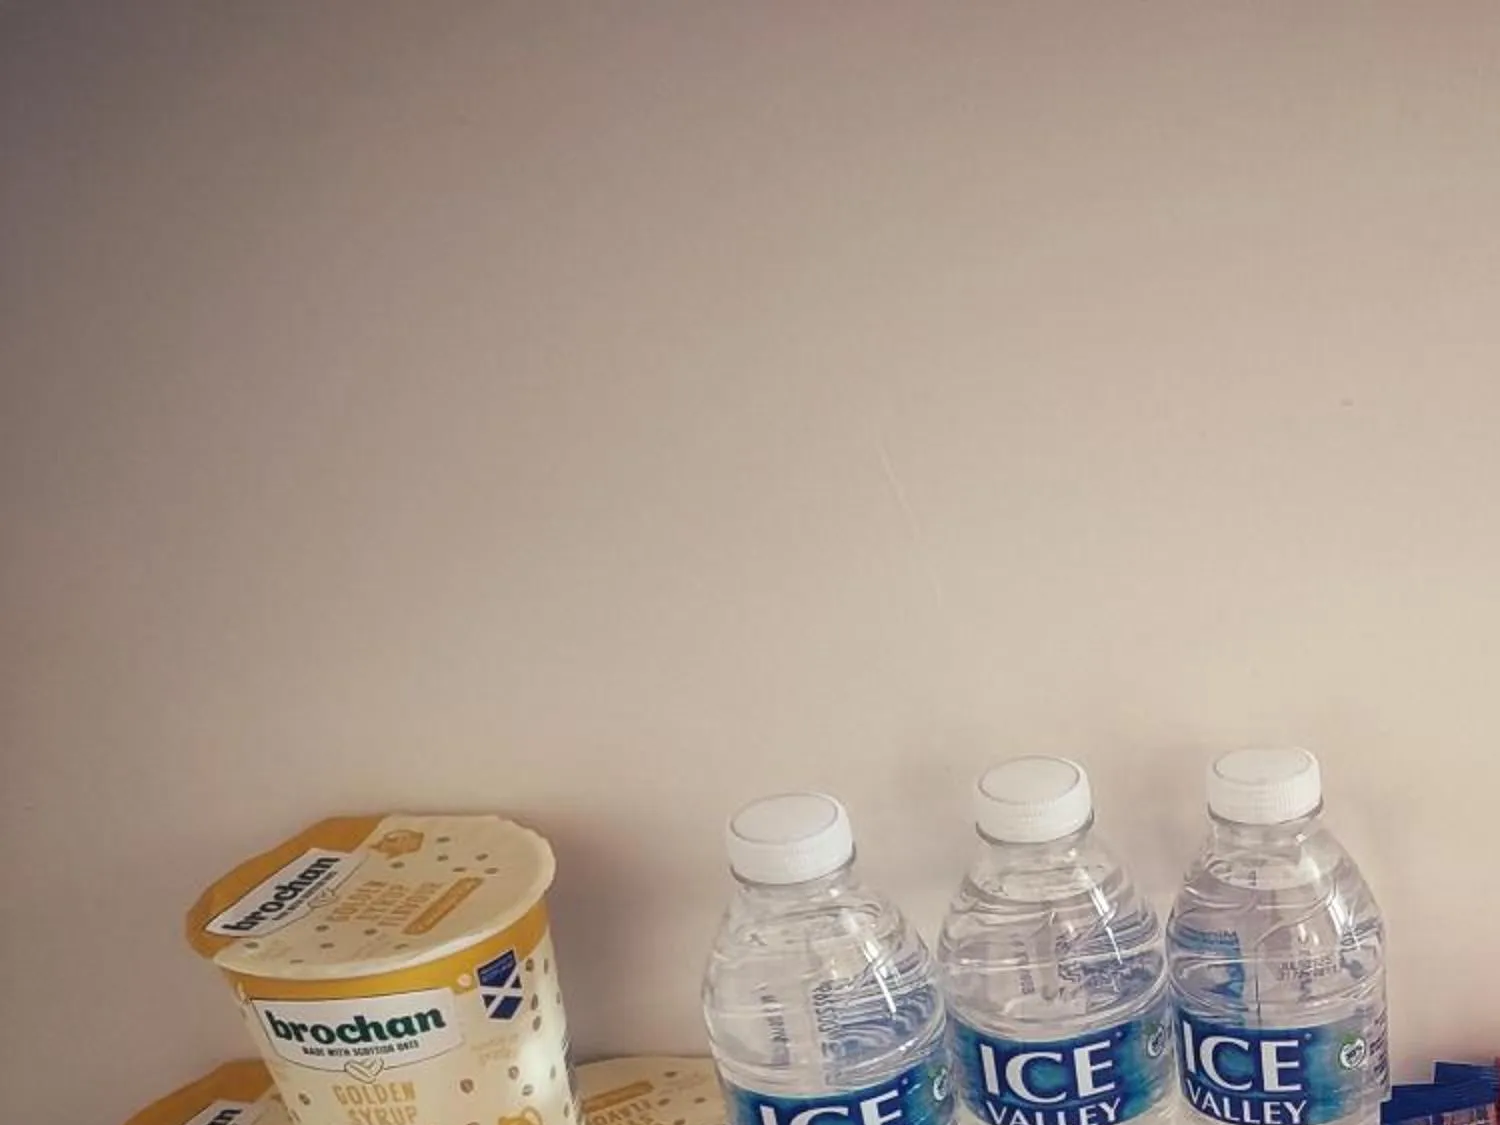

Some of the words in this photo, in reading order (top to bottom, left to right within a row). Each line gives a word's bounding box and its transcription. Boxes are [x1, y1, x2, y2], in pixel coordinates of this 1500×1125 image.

[220, 856, 341, 932] brochan
[264, 1008, 447, 1046] brochan
[980, 1039, 1116, 1104] ICE
[1183, 1020, 1303, 1093] ICE
[331, 1081, 417, 1105] GOLDEN
[1186, 1077, 1308, 1125] VALLEY
